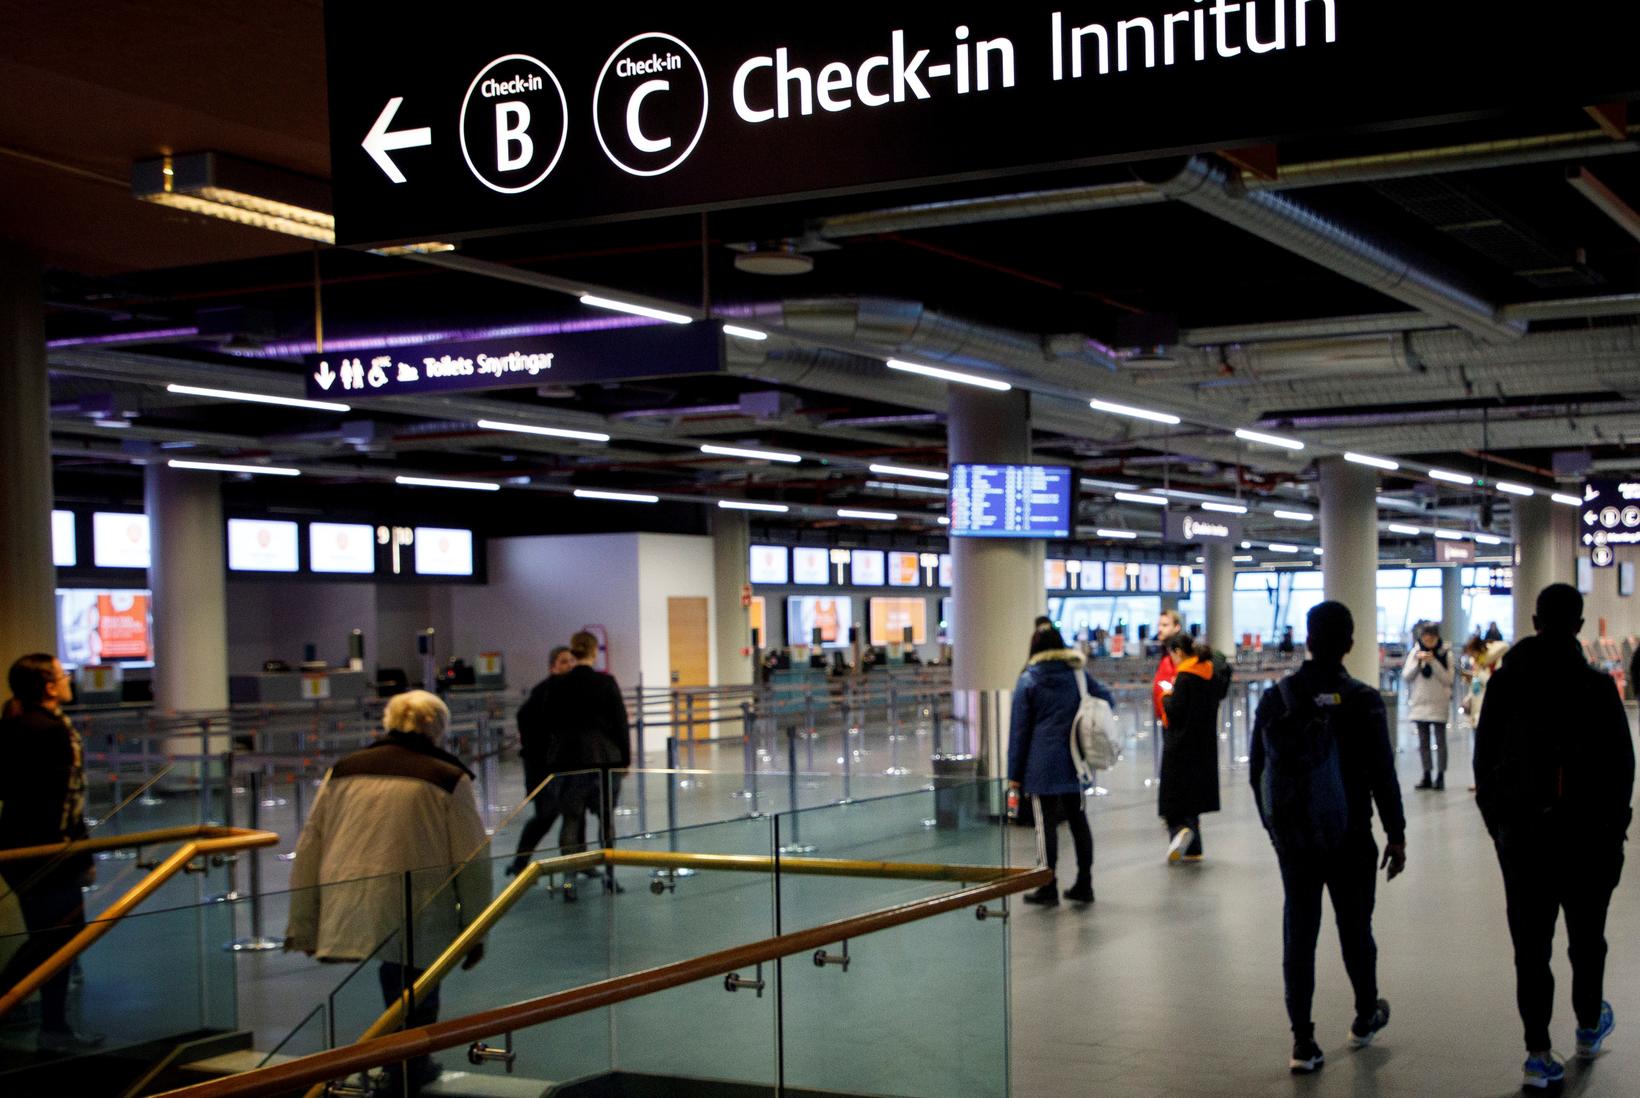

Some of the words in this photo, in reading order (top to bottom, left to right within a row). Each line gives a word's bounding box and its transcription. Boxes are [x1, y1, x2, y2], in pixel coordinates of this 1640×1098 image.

[481, 74, 543, 98] Check-in
[616, 53, 682, 78] Check-in
[732, 26, 1015, 123] Check-in
[1051, 0, 1336, 81] Innritun
[495, 101, 534, 172] B
[626, 79, 672, 153] C
[423, 355, 475, 378] Toilets
[476, 351, 555, 378] Snyrtingar
